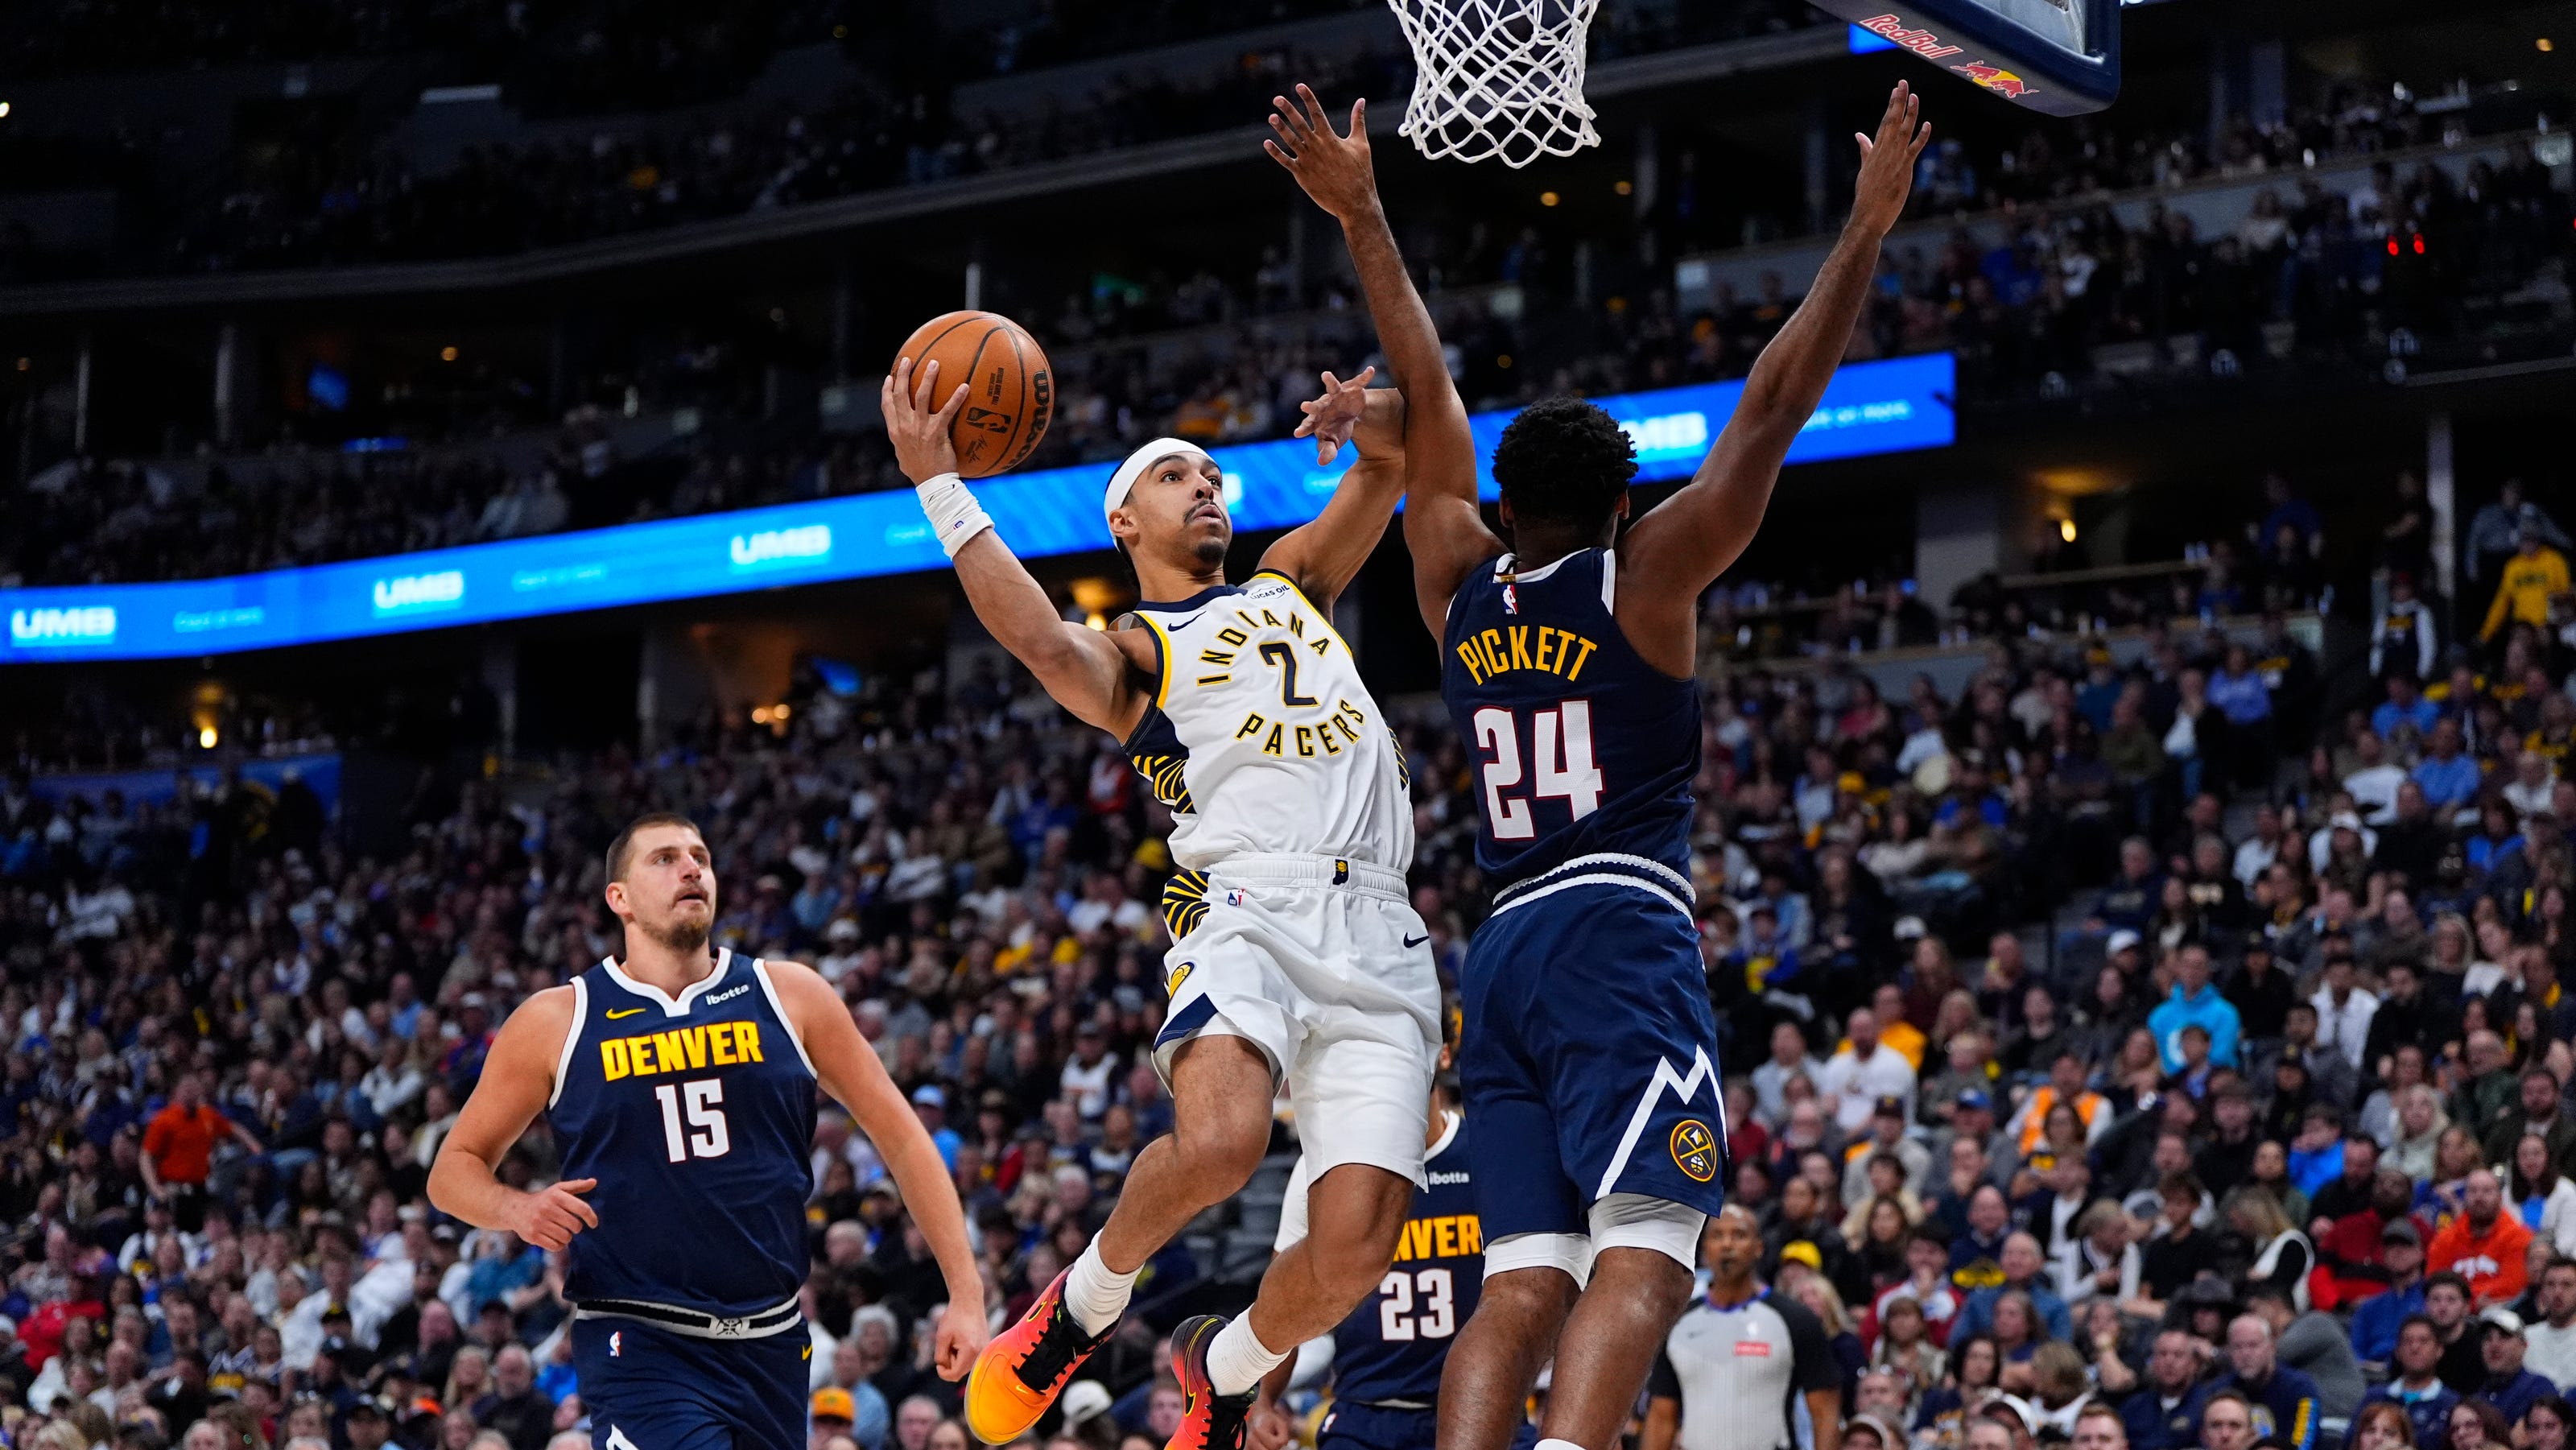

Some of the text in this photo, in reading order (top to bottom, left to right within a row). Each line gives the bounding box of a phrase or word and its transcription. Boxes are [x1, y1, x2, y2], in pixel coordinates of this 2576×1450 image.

[731, 524, 832, 566] UMB
[374, 571, 464, 609] UMB
[1250, 585, 1290, 599] LUCAS OIL
[12, 606, 116, 639] UMB
[1197, 609, 1331, 687] INDIANA
[1257, 641, 1320, 708] 2
[1456, 625, 1597, 685] PICKETT
[1234, 699, 1366, 758] PACERS
[1473, 696, 1607, 842] 24
[600, 1020, 764, 1082] DENVER
[654, 1078, 730, 1163] 15
[1379, 1267, 1455, 1342] 23
